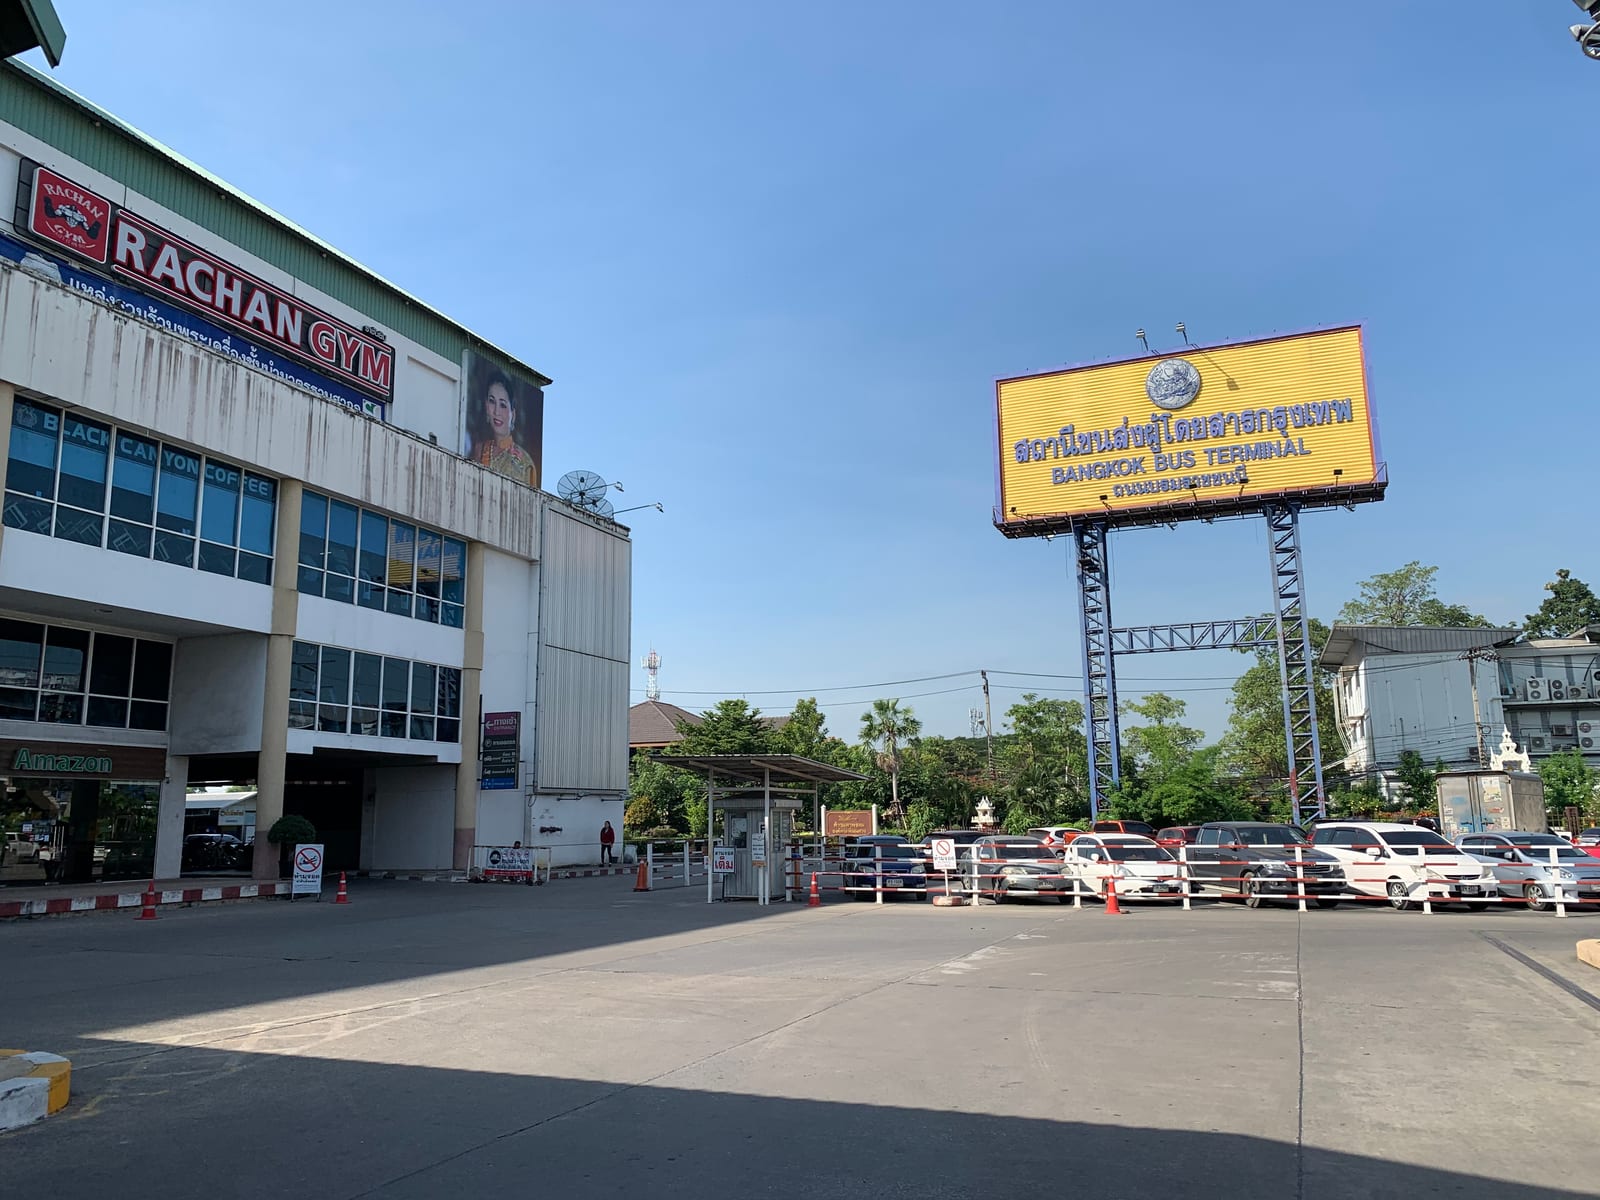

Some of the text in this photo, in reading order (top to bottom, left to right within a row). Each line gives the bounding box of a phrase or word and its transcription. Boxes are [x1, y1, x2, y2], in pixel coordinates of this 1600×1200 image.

[43, 183, 104, 219] RACHAN
[115, 219, 392, 390] RACHAN GYM
[1013, 397, 1353, 463] สถานีขนส่งผู้โดยสารกรุงเทพ
[1051, 437, 1311, 485] BANGKOK BUS TERMINAL
[14, 747, 113, 773] Amazon
[715, 855, 733, 870] เต็ม
